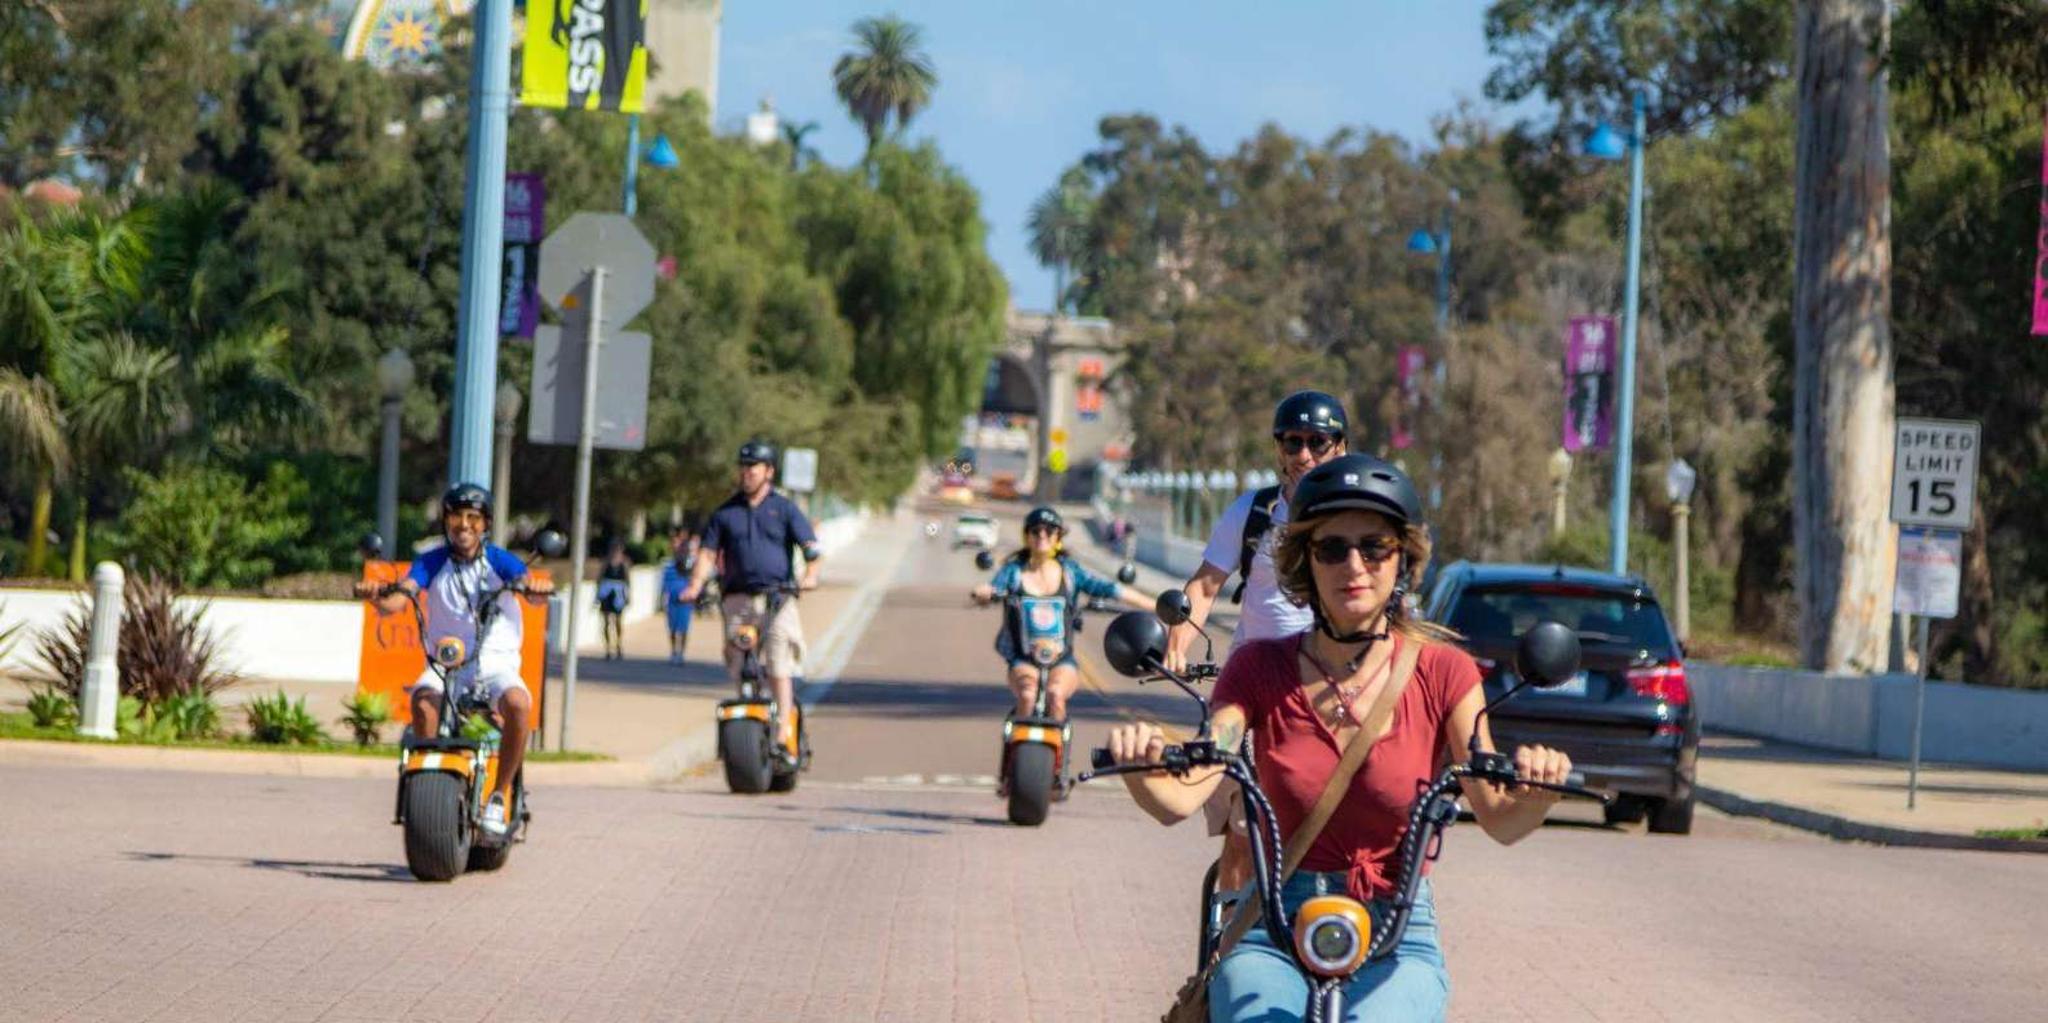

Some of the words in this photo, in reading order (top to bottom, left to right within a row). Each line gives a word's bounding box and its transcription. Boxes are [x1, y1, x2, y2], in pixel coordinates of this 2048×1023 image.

[1901, 430, 1973, 451] SPEED
[1905, 454, 1963, 473] LIMIT
[1908, 479, 1956, 516] 15
